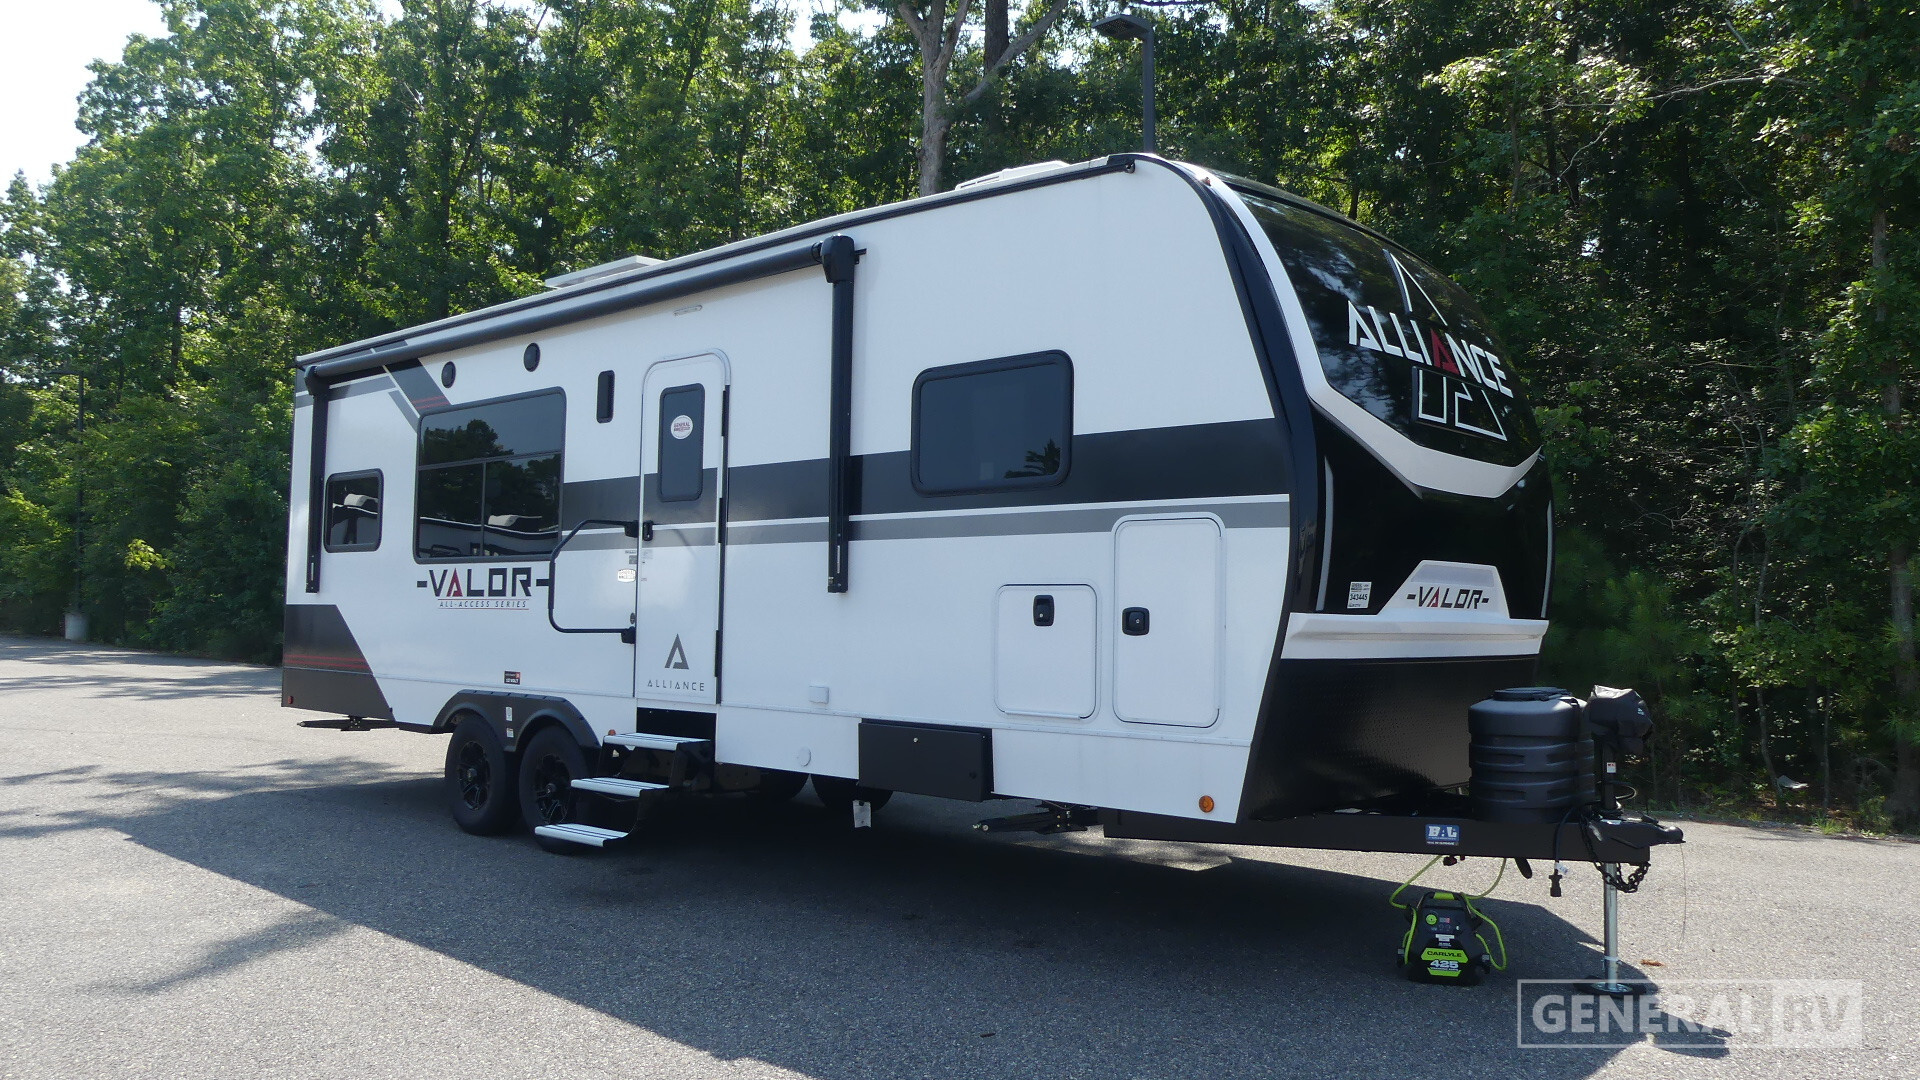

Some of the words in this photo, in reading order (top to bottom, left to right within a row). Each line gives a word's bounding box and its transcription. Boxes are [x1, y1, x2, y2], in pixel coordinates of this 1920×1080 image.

[1348, 300, 1514, 398] ALLIANCE
[1349, 593, 1368, 601] 343445
[439, 600, 490, 608] ALL-ACCESS
[495, 600, 526, 608] SERIES
[647, 679, 705, 692] ALLIANCE
[1426, 950, 1462, 958] CARLYLE
[1429, 959, 1459, 969] 425
